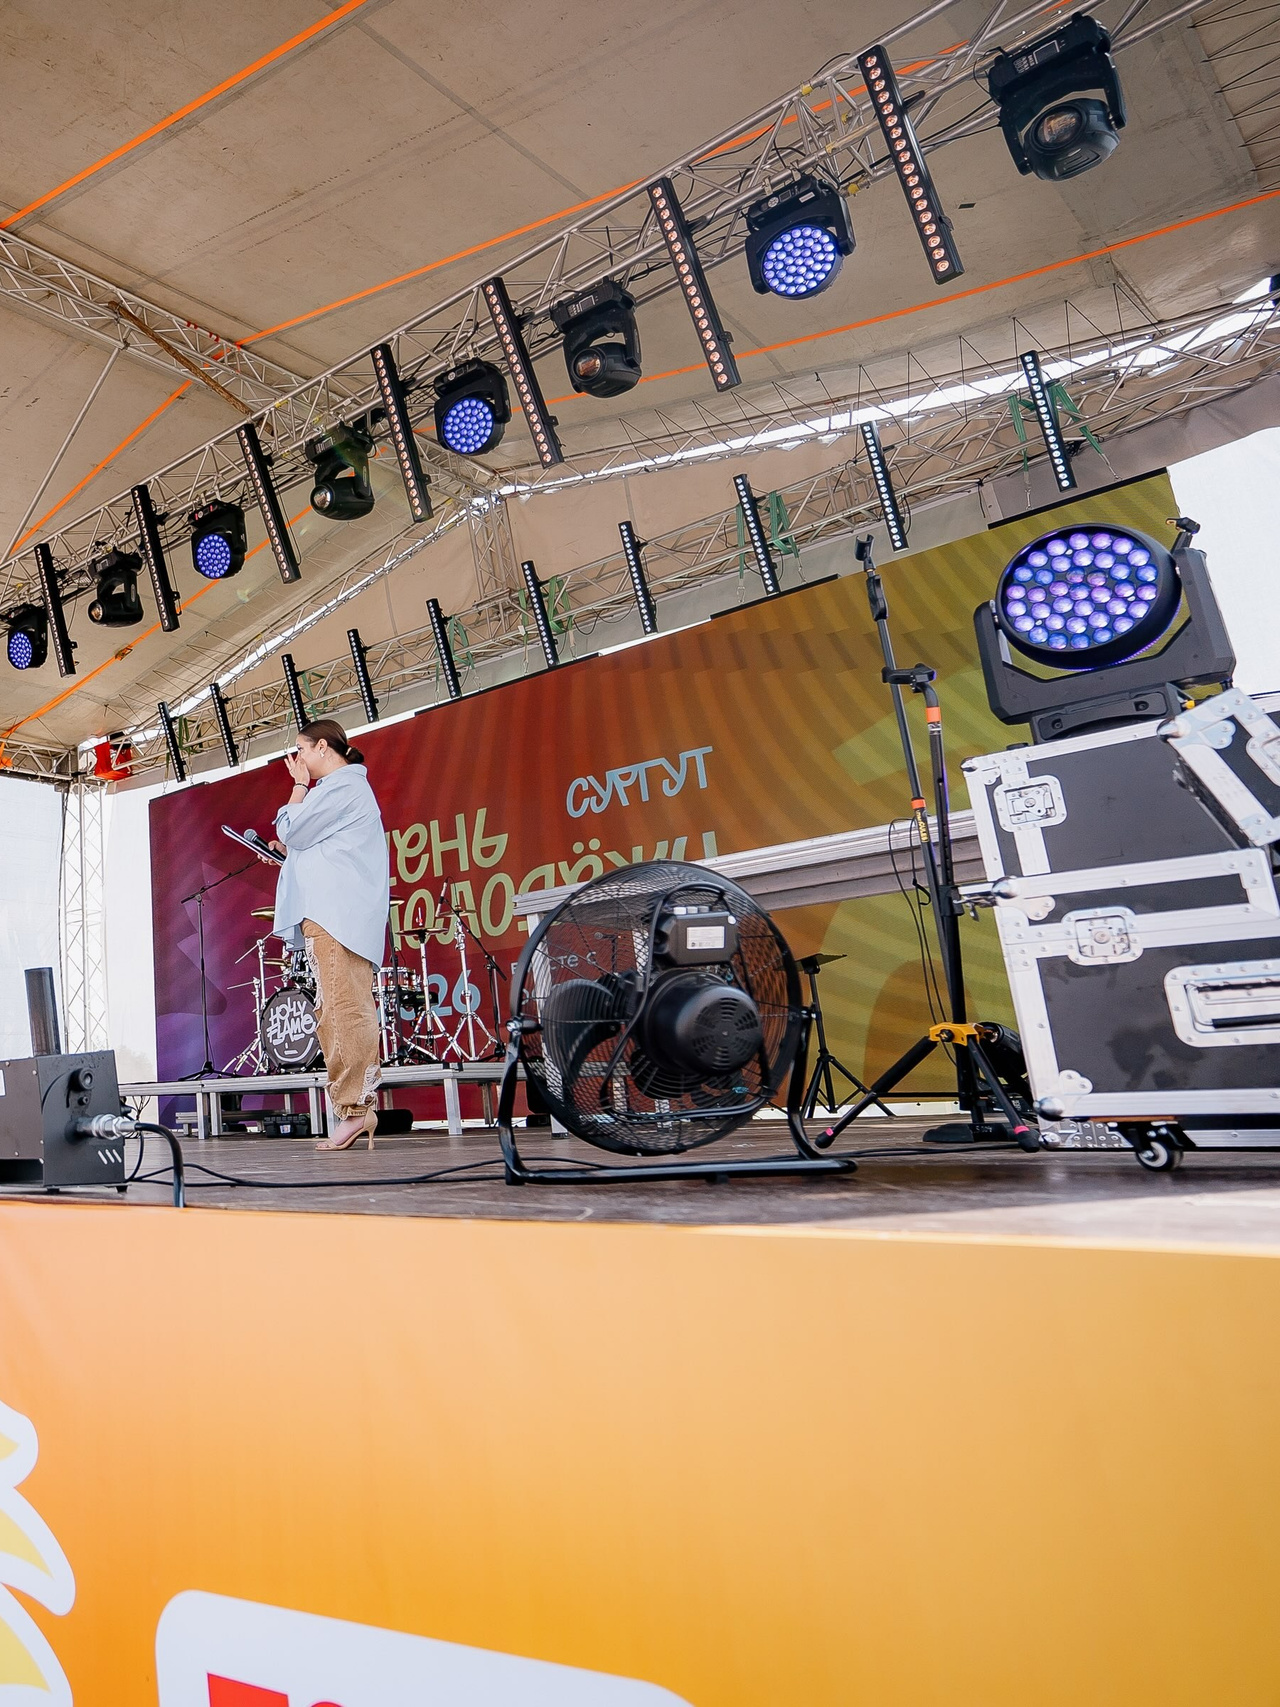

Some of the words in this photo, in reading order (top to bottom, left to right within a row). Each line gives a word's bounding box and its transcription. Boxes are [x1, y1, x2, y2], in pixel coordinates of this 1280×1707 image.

[566, 745, 713, 818] СУРГУТ
[385, 807, 509, 886] ЕНЬ
[269, 997, 307, 1028] HOLLY
